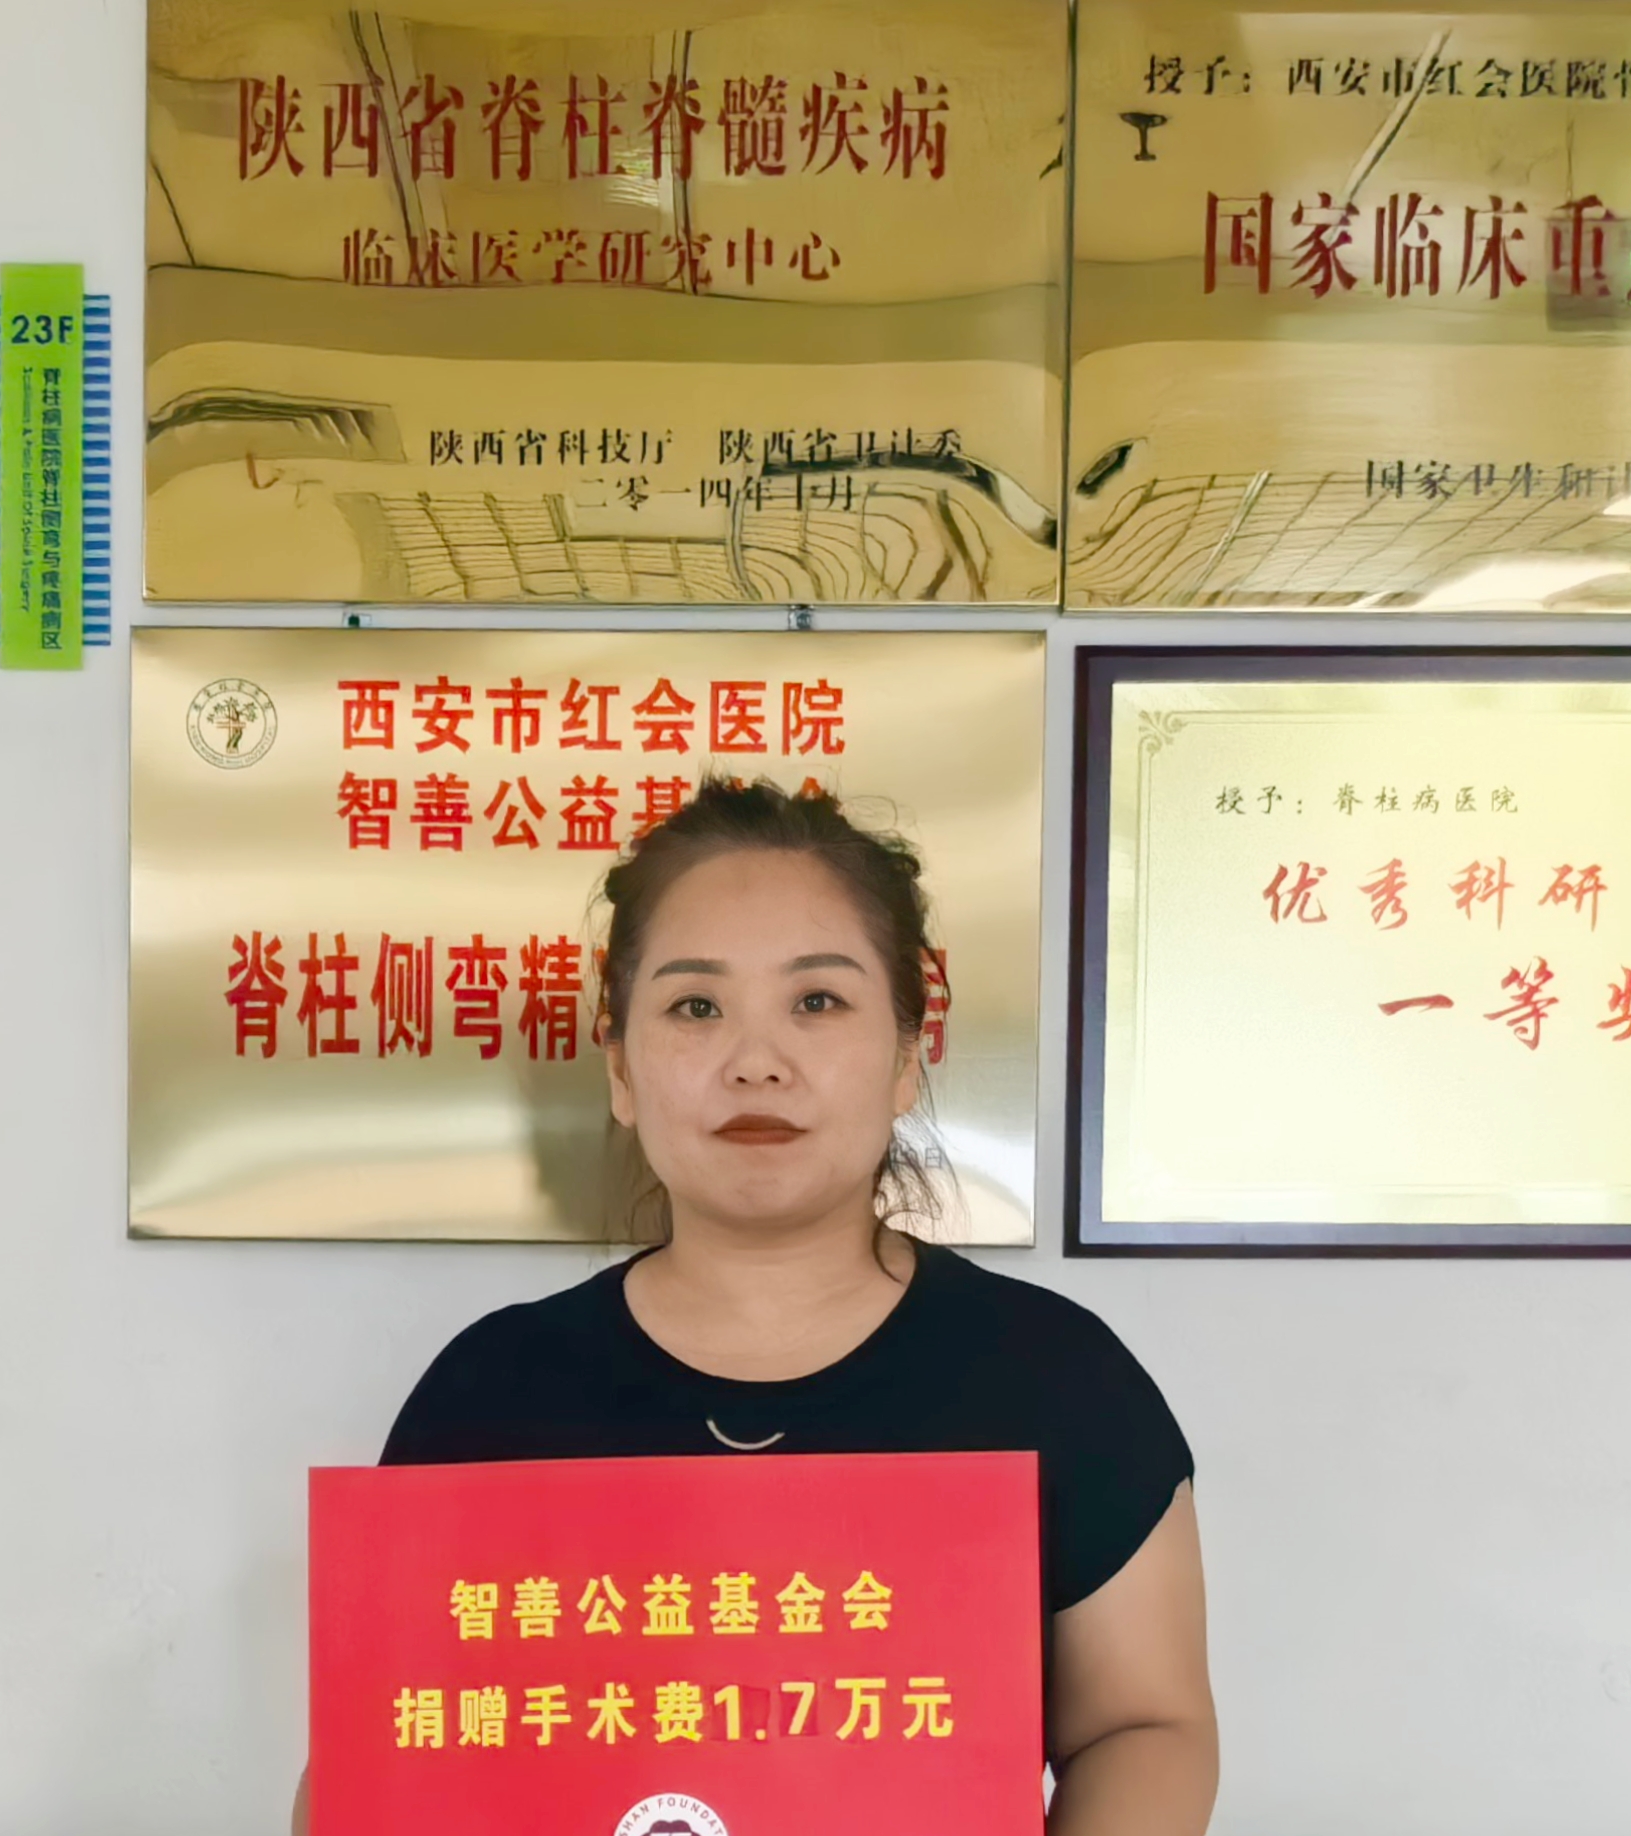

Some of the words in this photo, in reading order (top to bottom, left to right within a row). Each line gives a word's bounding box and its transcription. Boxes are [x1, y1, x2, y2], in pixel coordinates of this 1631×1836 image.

[237, 71, 951, 183] 陕西省脊柱脊髓疾病
[342, 227, 841, 291] 临床医学研究中心
[11, 314, 74, 345] 23F
[429, 428, 673, 467] 陕西省科技厅
[337, 675, 847, 756] 西安市红会医院
[336, 770, 840, 852] 智善公益基
[450, 1569, 893, 1641] 智善公益基金会
[392, 1675, 956, 1750] 捐赠手术费1.7万元
